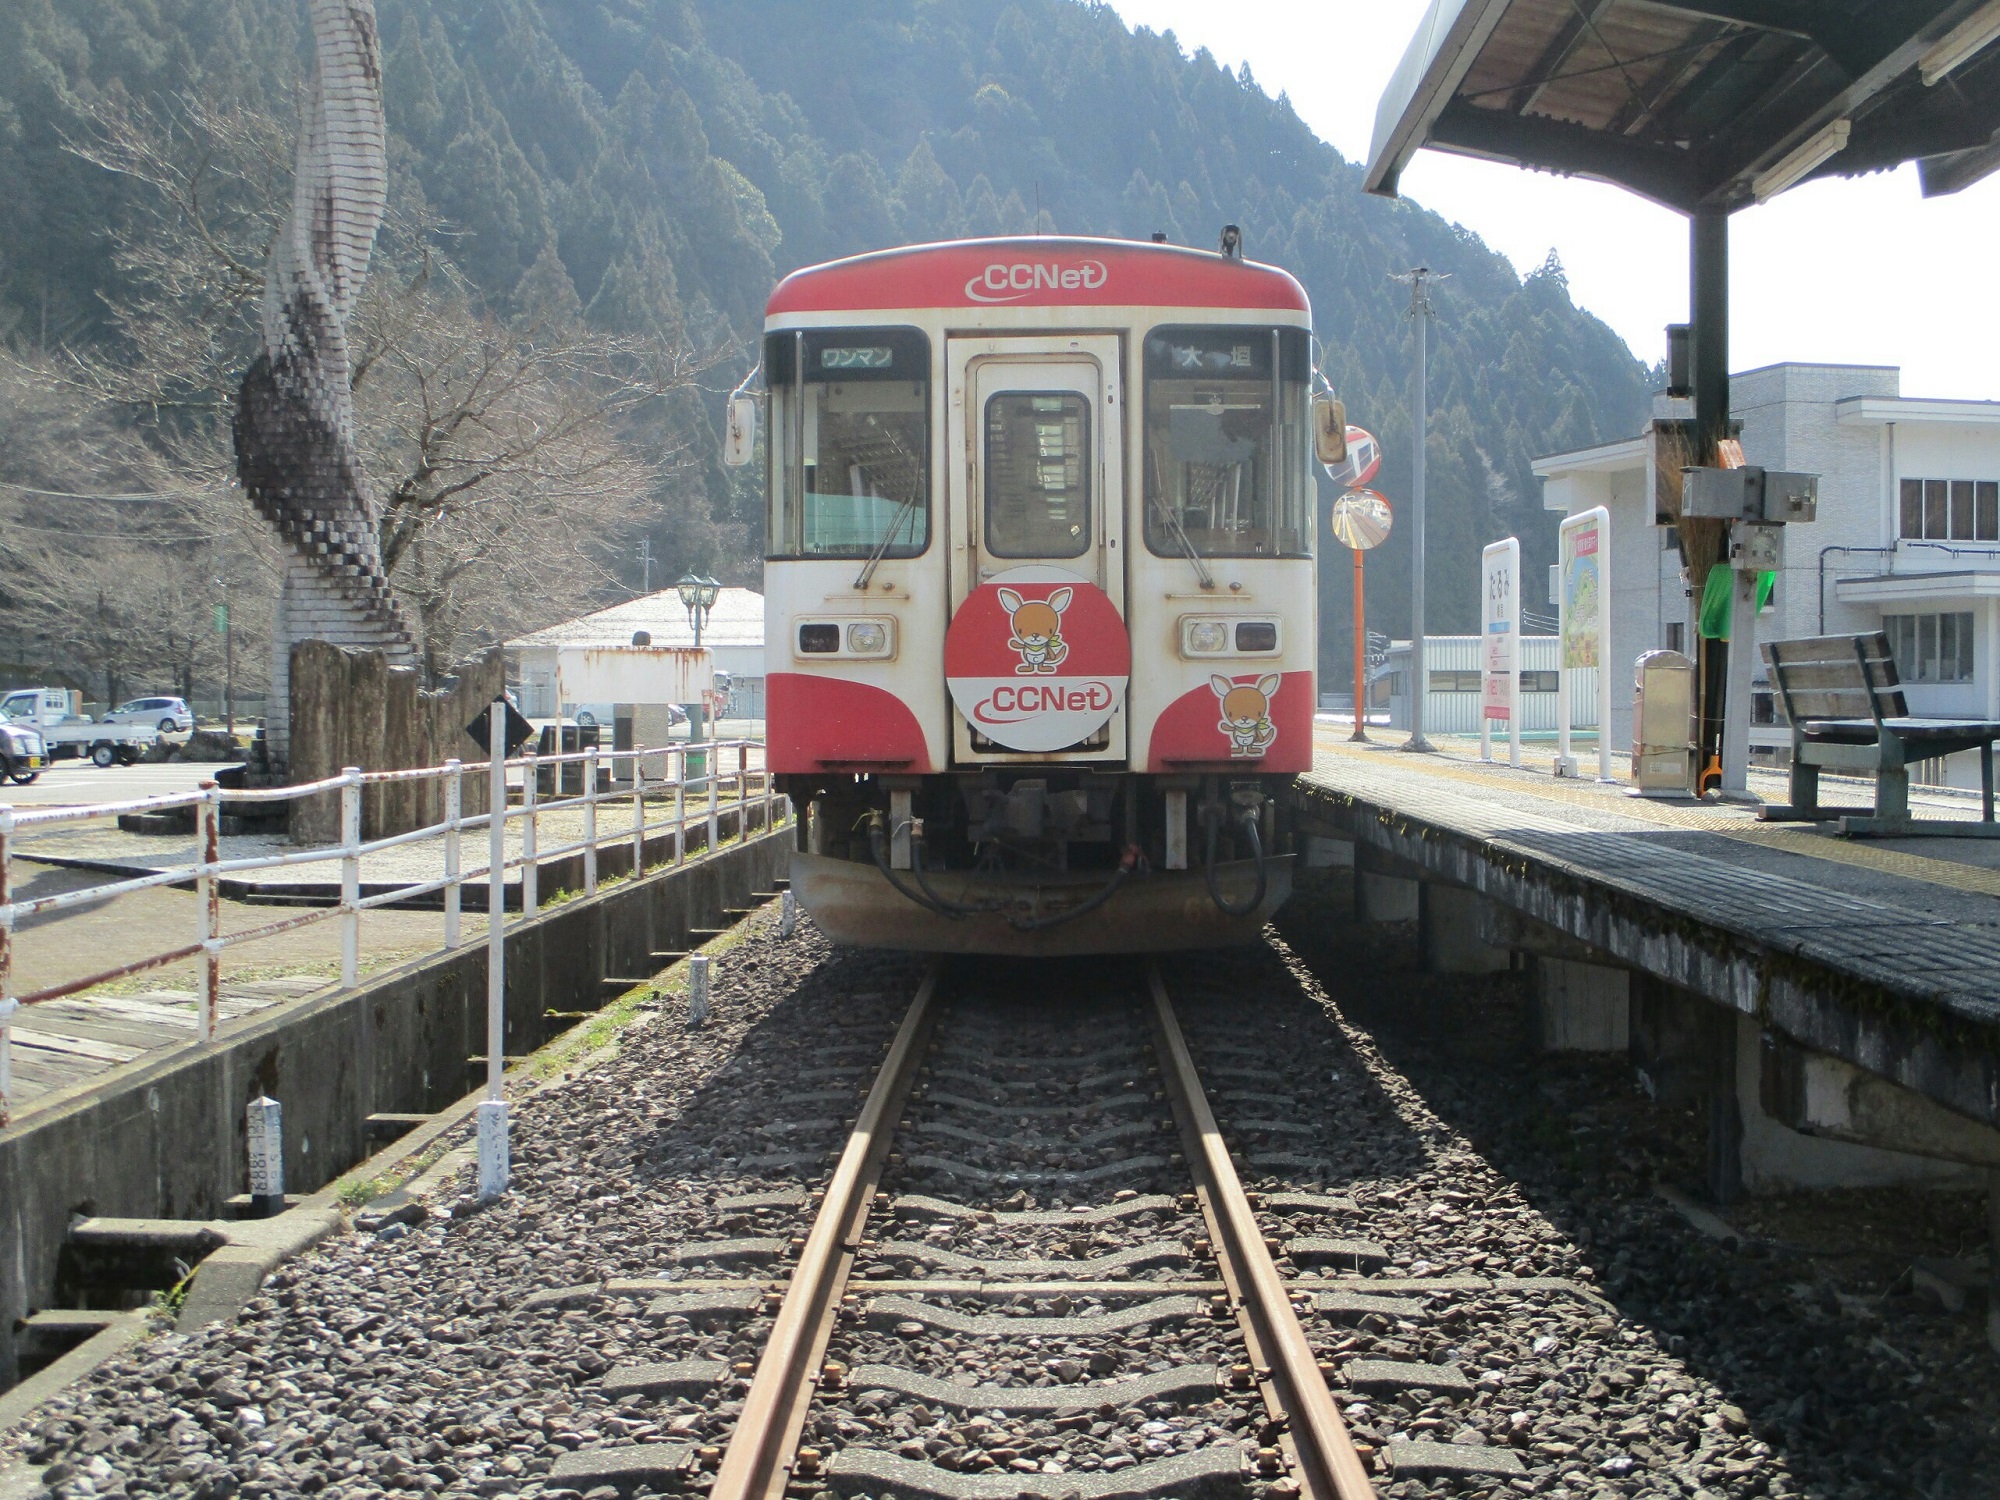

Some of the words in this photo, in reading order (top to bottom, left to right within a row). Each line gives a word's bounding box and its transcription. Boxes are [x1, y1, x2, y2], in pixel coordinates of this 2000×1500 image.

[983, 260, 1108, 291] CCNet
[823, 347, 893, 367] ワンマン
[1181, 345, 1252, 367] 大垣
[991, 680, 1113, 712] CCNet
